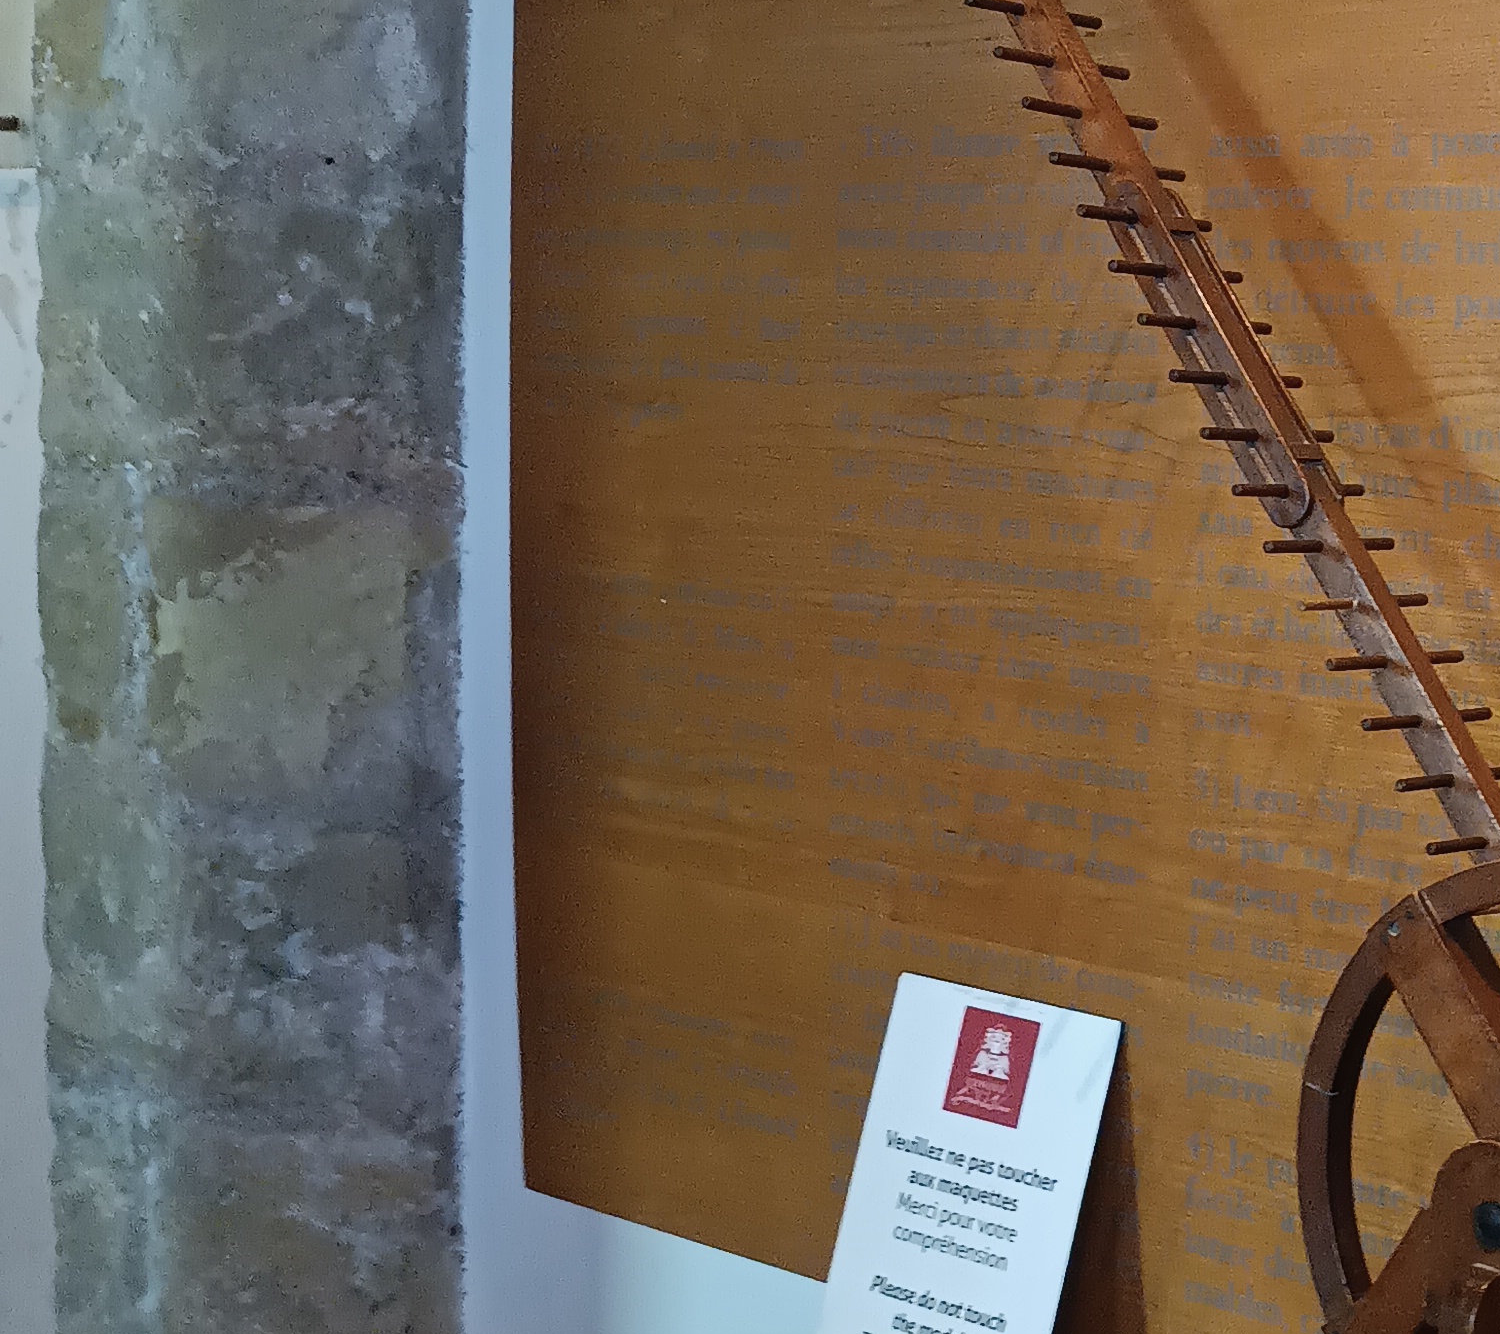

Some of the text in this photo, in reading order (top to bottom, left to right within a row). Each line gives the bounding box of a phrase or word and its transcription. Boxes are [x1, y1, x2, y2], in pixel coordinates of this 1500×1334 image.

[886, 1129, 1058, 1191] Veuillez ne pas toucher
[908, 1170, 1019, 1212] aux maquettes
[895, 1192, 1018, 1242] Merci pour votre
[892, 1225, 1008, 1271] compréhension
[869, 1275, 1007, 1333] Please do not touch
[892, 1313, 916, 1334] the
